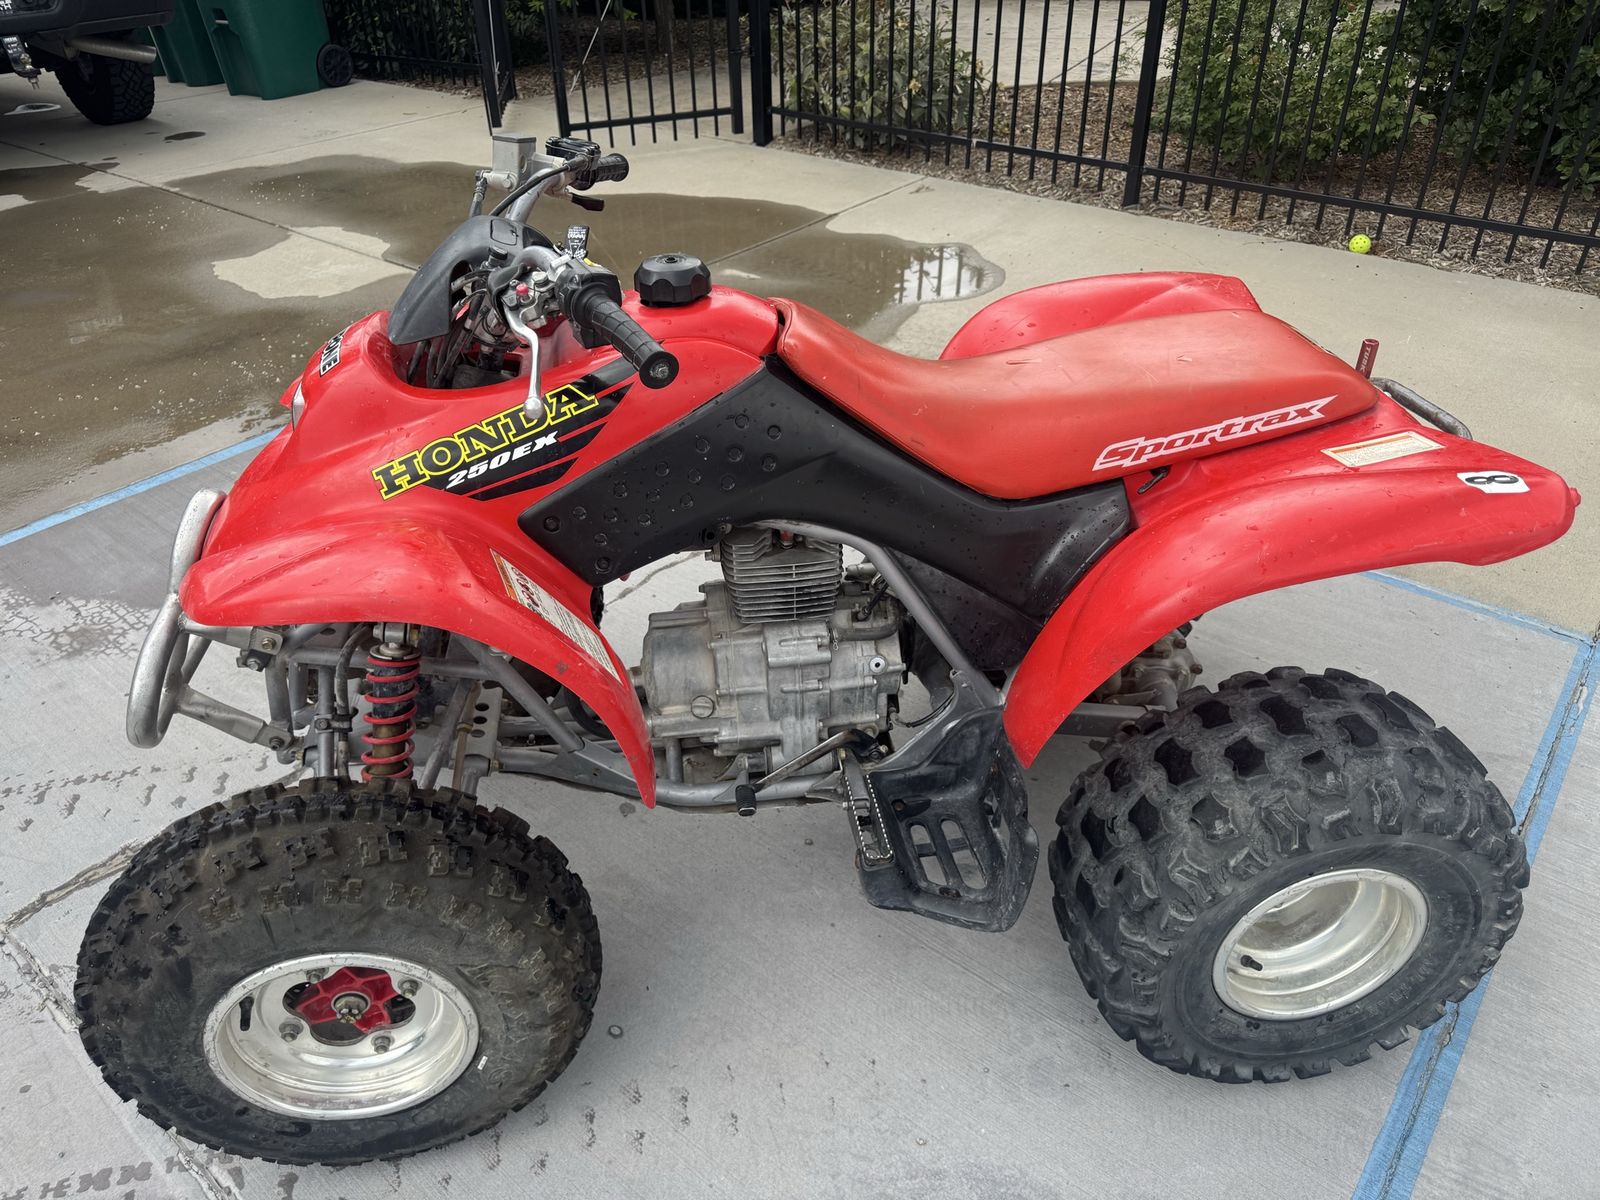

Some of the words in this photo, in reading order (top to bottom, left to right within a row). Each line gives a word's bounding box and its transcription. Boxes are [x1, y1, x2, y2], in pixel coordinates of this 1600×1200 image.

[371, 383, 599, 500] HONDA
[445, 430, 559, 491] 250EX
[1092, 394, 1338, 471] Sportrax
